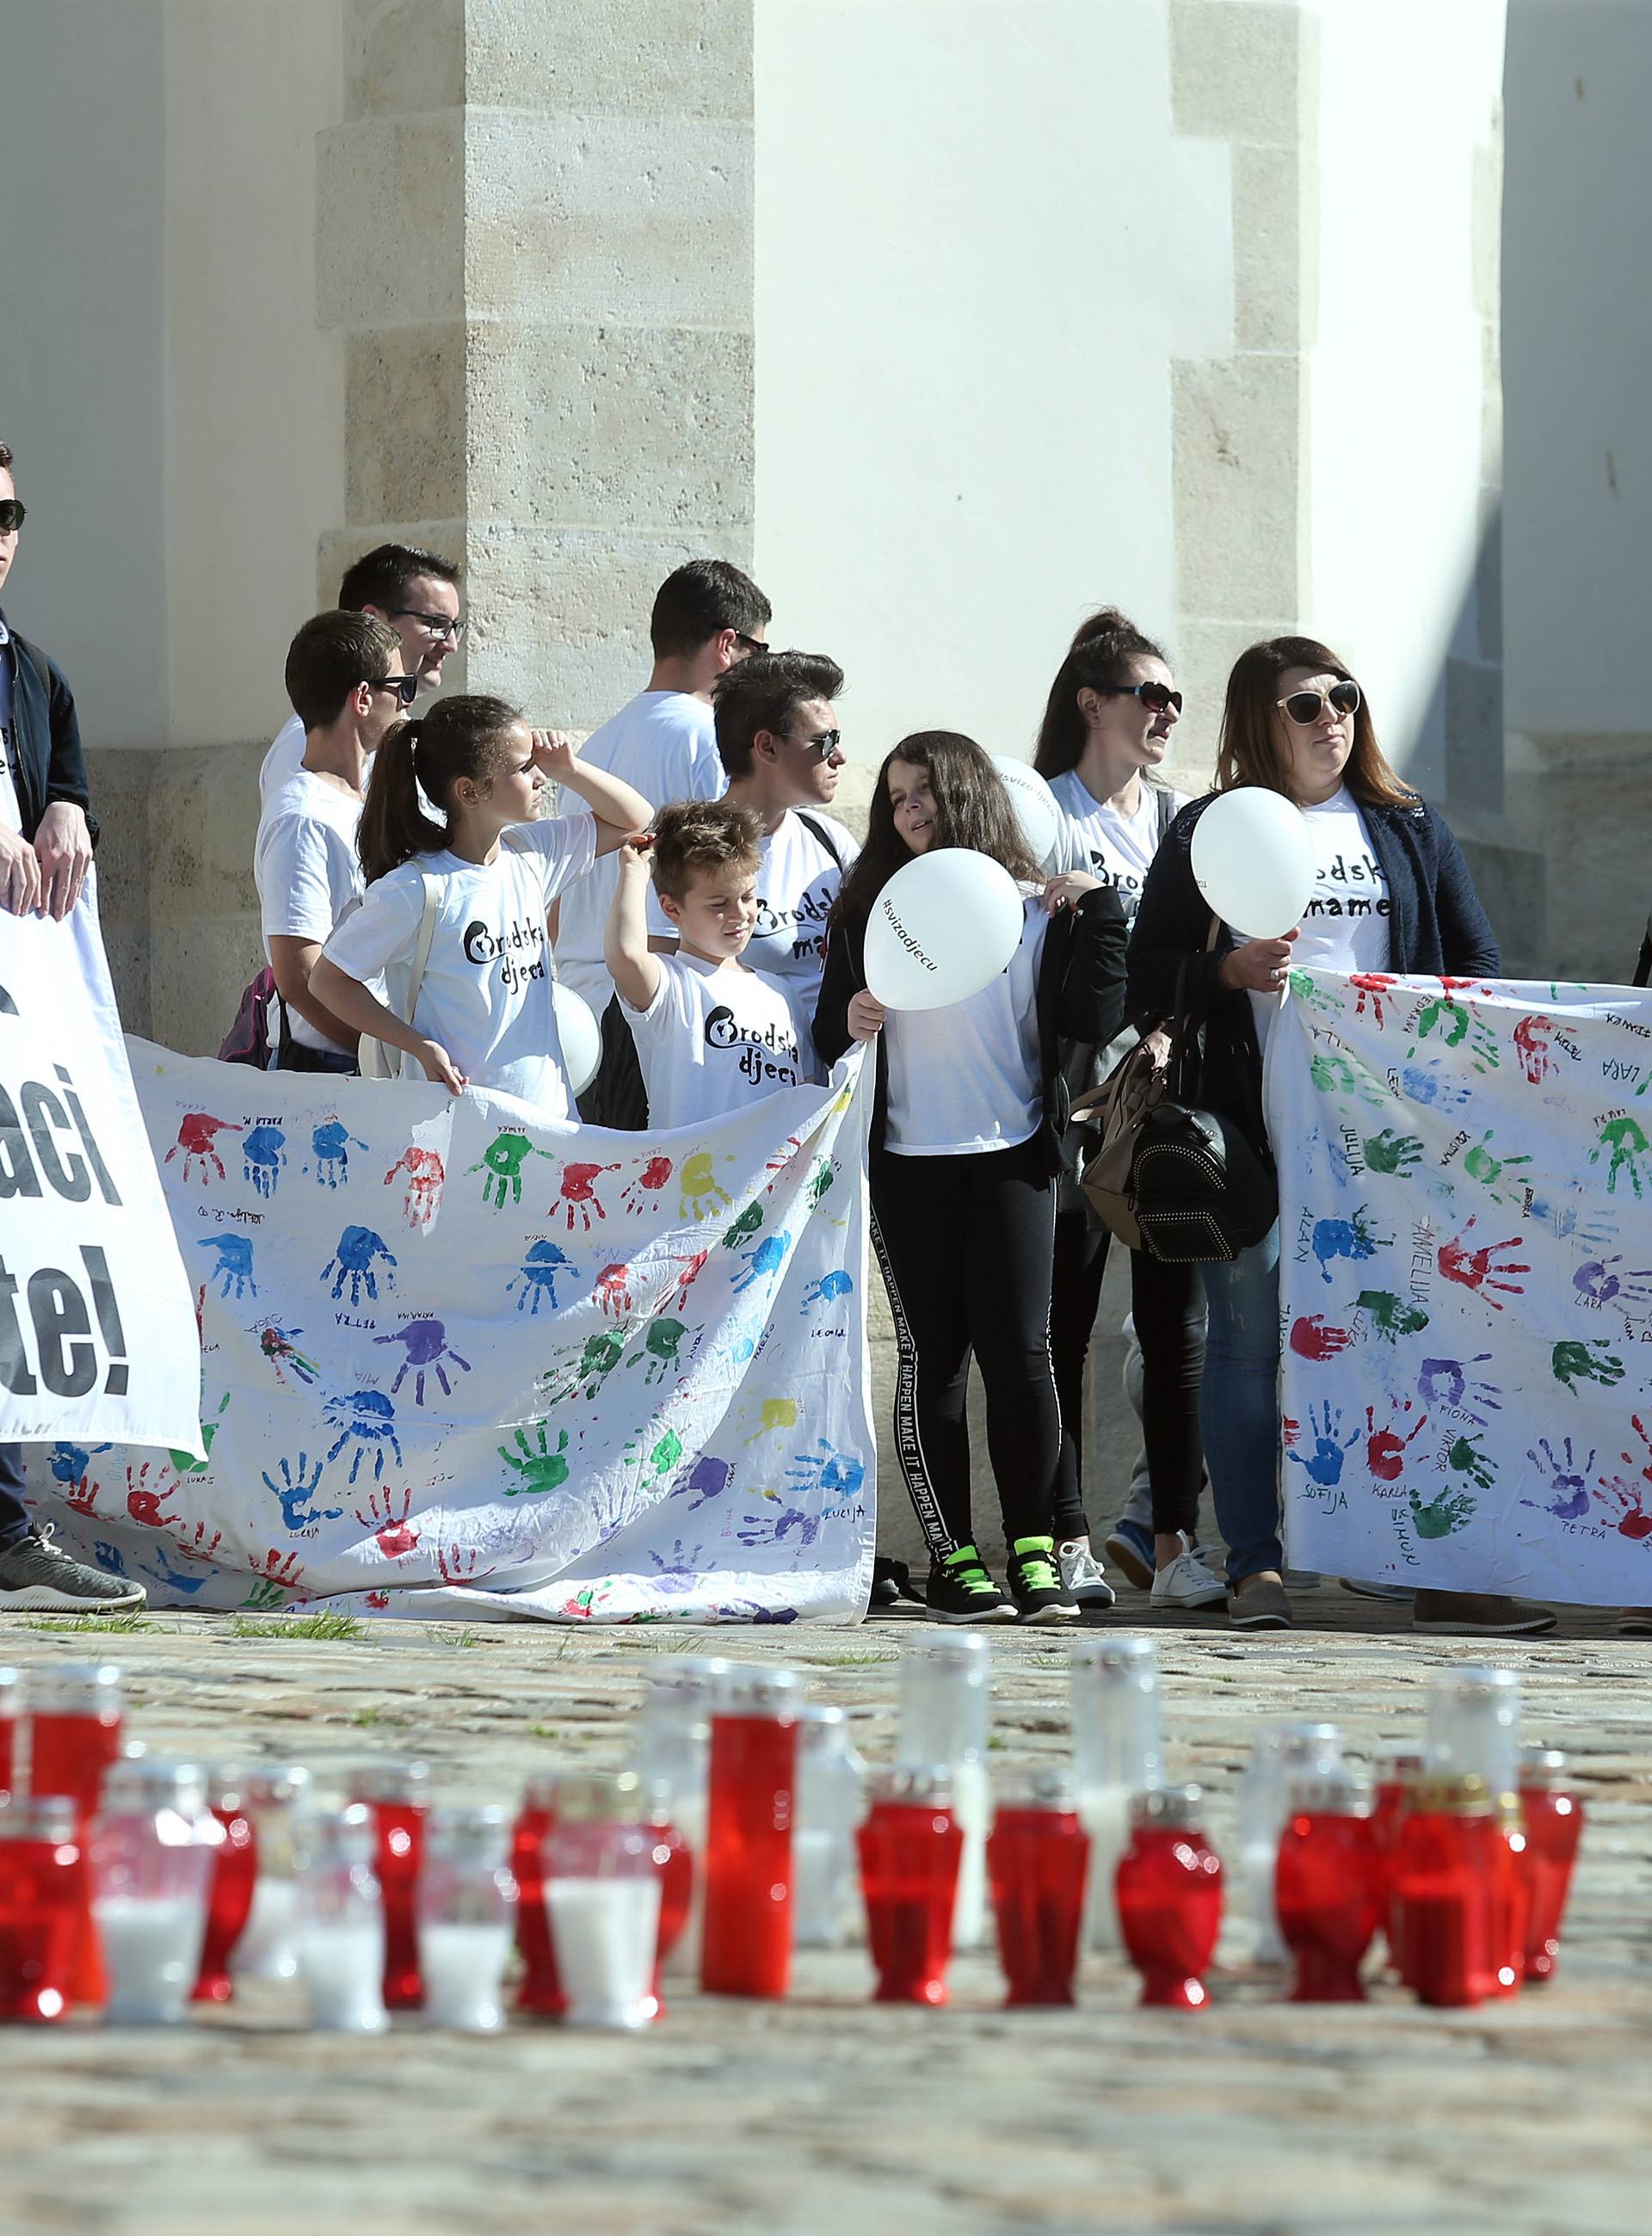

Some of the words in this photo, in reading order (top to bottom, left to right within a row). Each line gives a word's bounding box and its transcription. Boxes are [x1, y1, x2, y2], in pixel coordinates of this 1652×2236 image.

[1302, 897, 1391, 919] mame
[882, 898, 940, 972] #svizadjecu
[501, 956, 546, 995] djeca
[1602, 1058, 1640, 1083] LARA
[1340, 1123, 1365, 1177] JULIJA
[1574, 1290, 1603, 1312] LARA
[334, 1312, 377, 1330] PETRA
[897, 1316, 912, 1352] MAKE
[900, 1364, 914, 1412] HAPPEN
[1439, 1403, 1476, 1427] FIONA
[900, 1415, 917, 1452] MAKE
[904, 1455, 921, 1469] IT
[1432, 1428, 1458, 1474] VIKTOR
[909, 1471, 937, 1520] HAPPEN
[1297, 1483, 1348, 1514] SOFIJA
[823, 1505, 867, 1524] LUCIJA
[1561, 1520, 1607, 1541] PETRA
